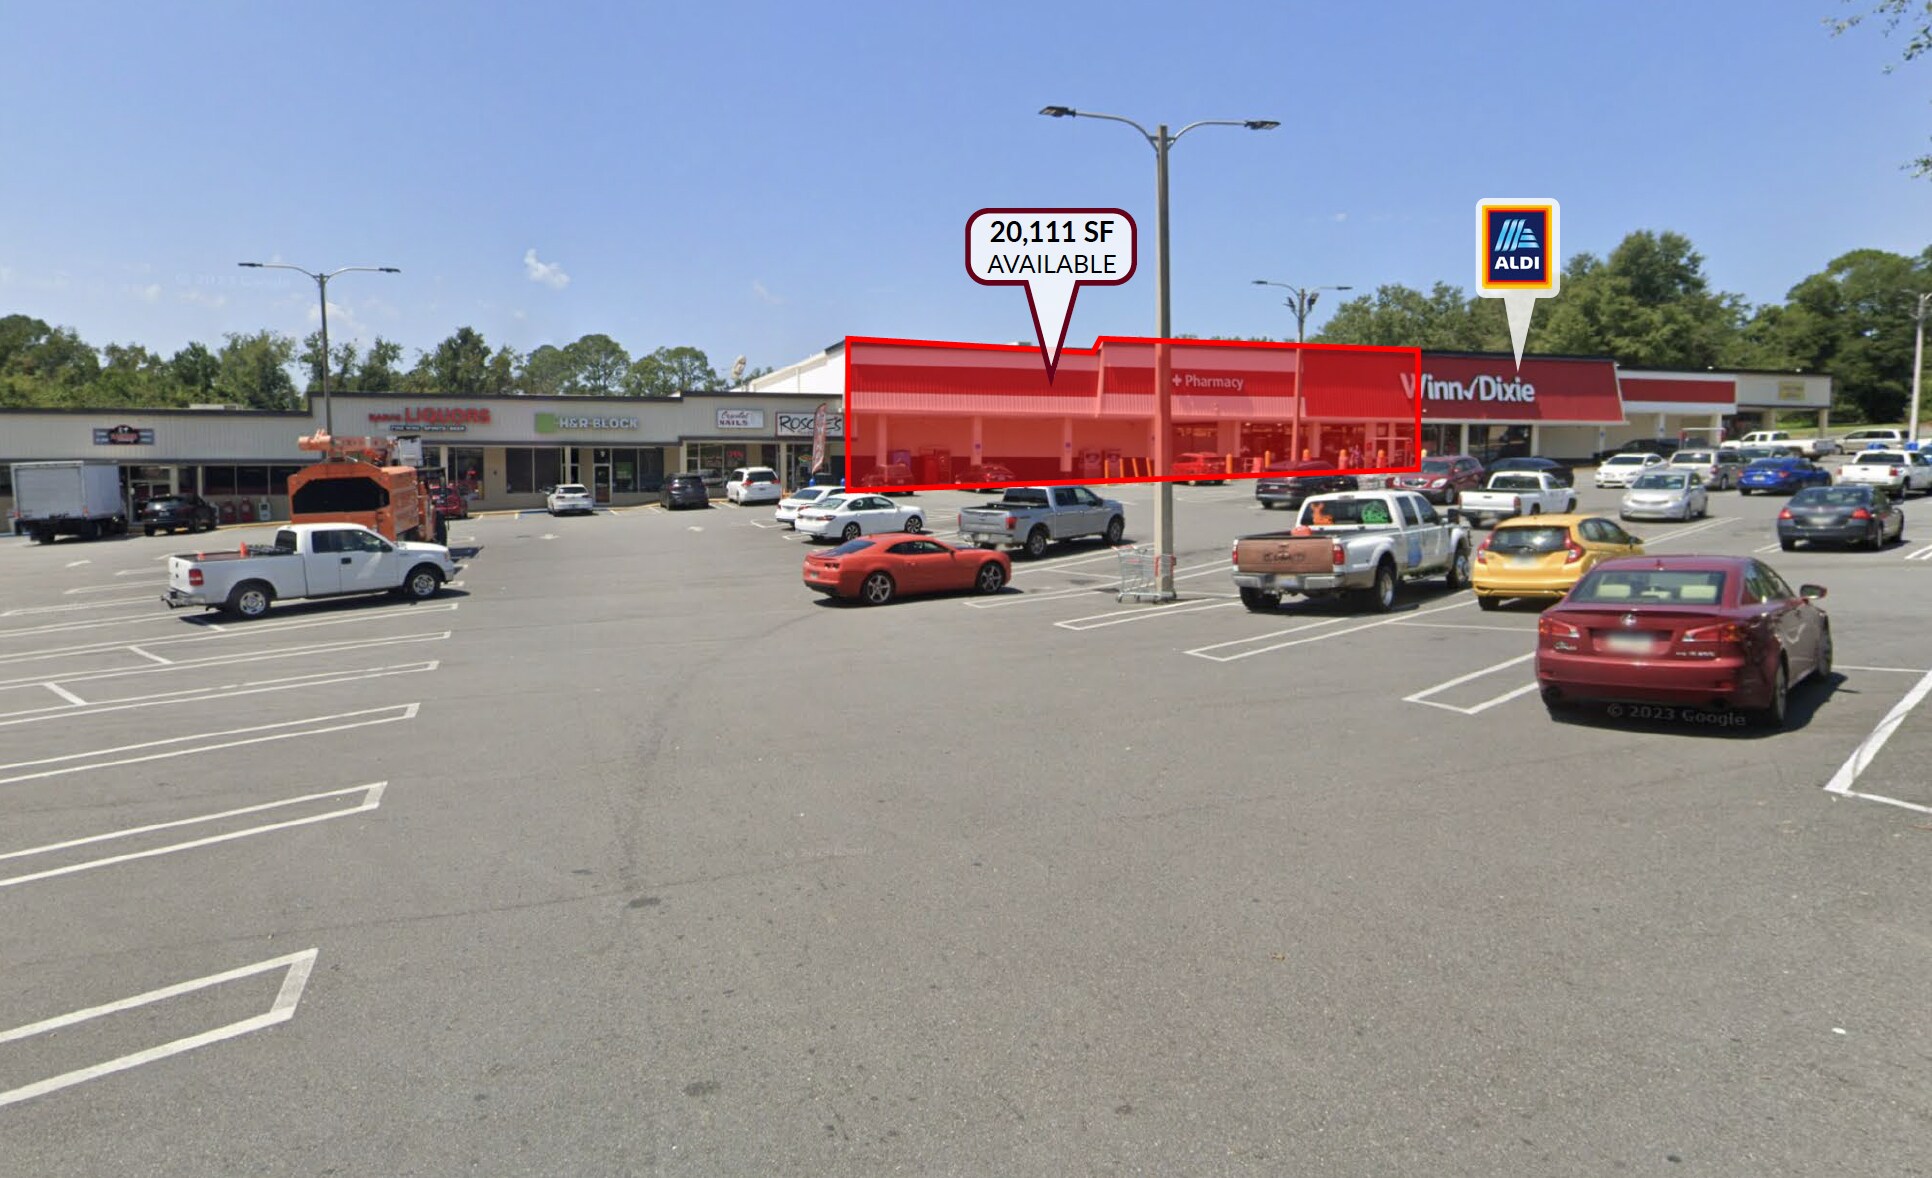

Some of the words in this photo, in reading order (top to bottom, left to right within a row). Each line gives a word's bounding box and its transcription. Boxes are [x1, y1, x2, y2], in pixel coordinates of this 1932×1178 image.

[1184, 374, 1244, 391] Pharmacy
[404, 407, 491, 425] LIQUORS
[559, 417, 589, 429] H&R
[592, 417, 640, 430] BLOCK
[779, 415, 842, 434] ROSCE'S
